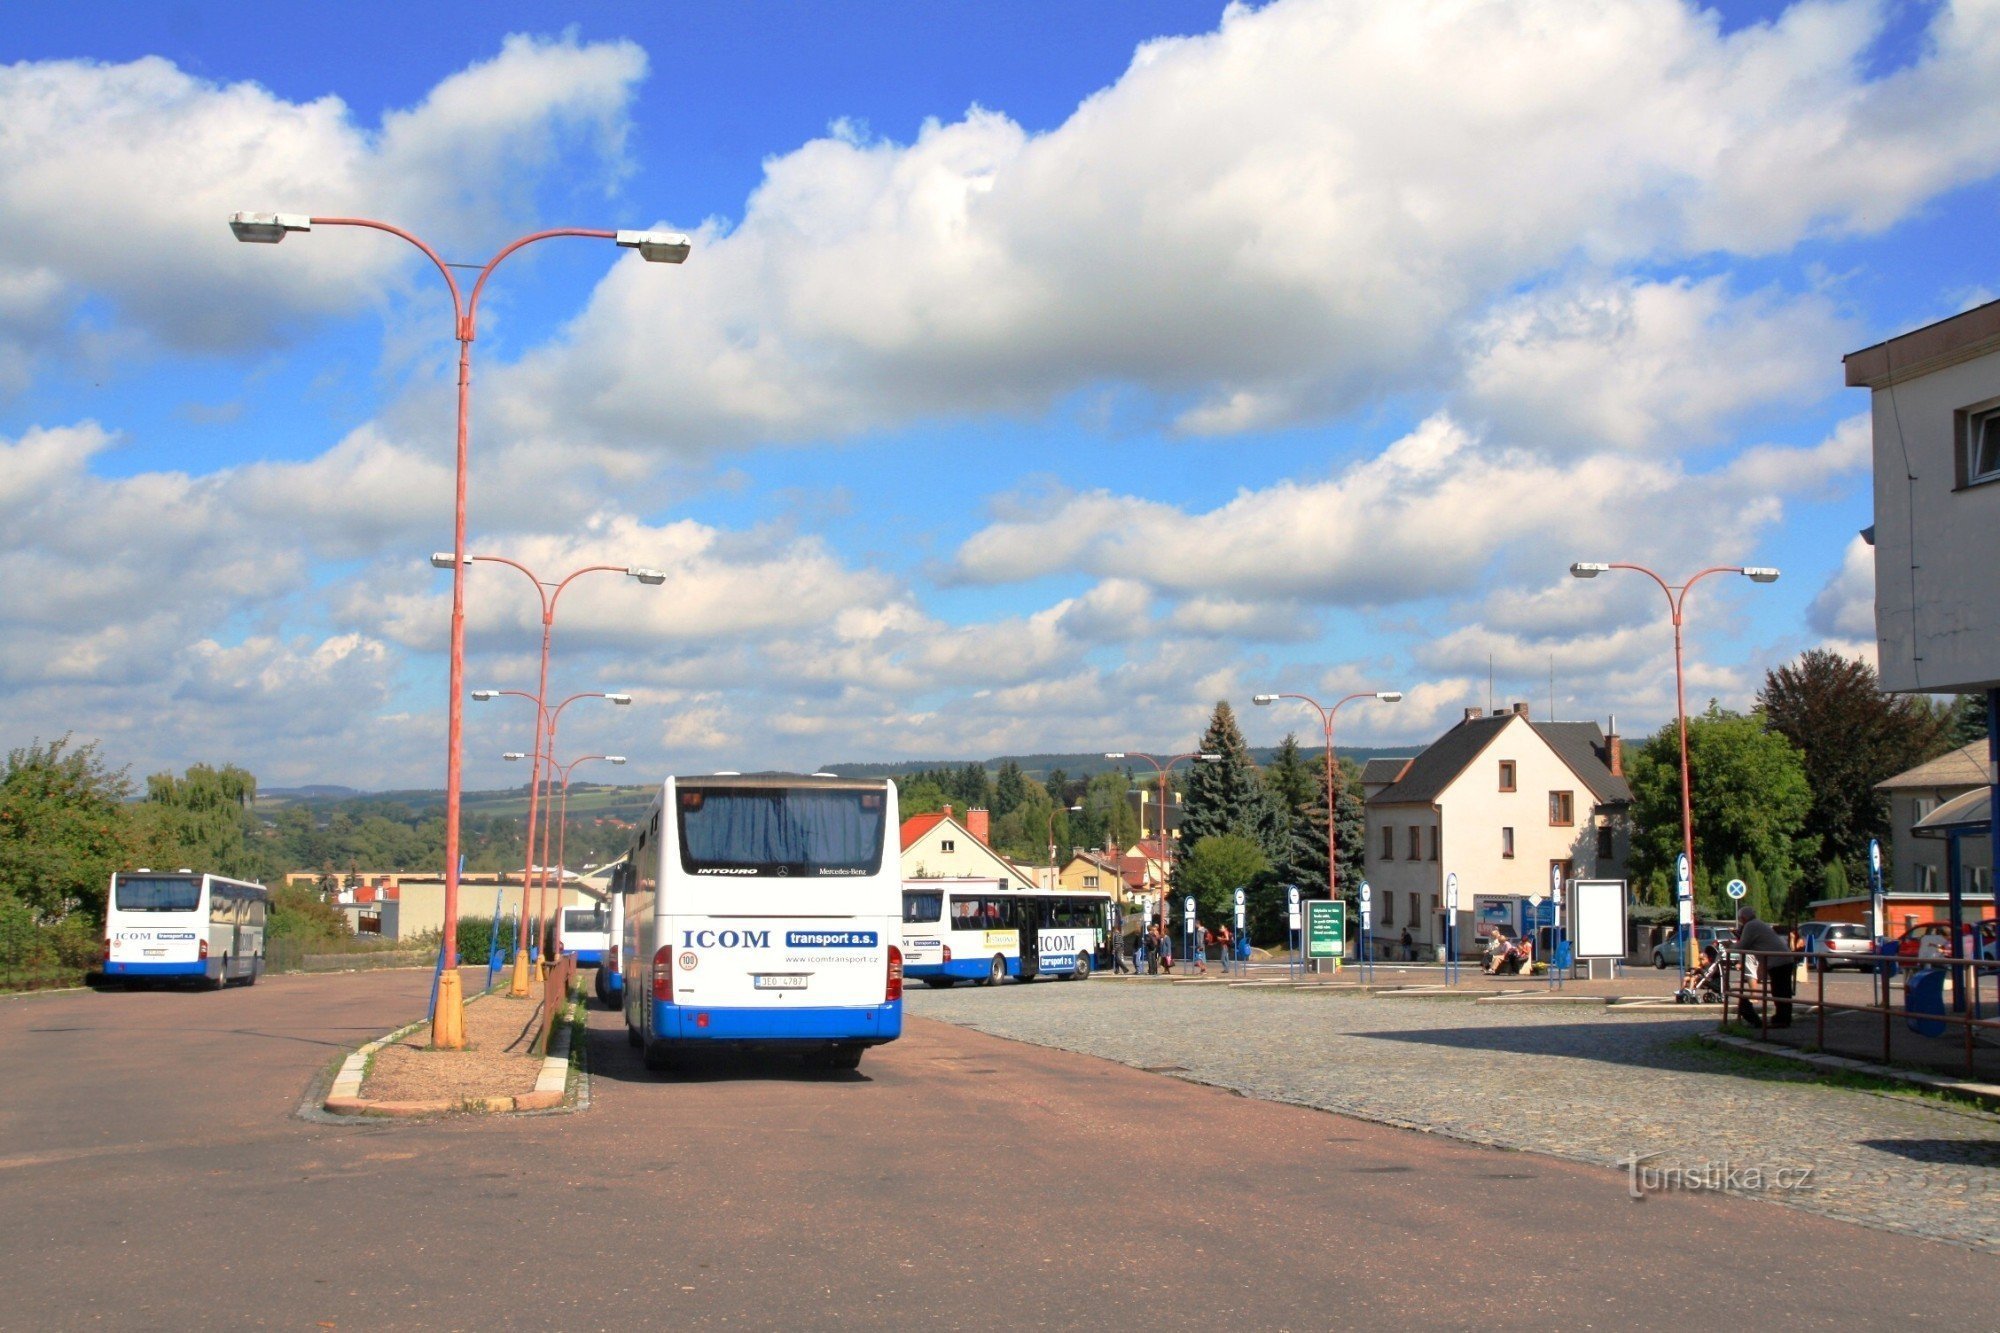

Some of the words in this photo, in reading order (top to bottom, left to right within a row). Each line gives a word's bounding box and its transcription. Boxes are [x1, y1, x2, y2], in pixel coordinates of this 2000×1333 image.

[682, 930, 771, 948] ICOM
[791, 933, 849, 946] transport
[851, 934, 874, 944] a.s.
[1039, 936, 1075, 951] ICOM
[785, 956, 879, 965] www.icomtransport.cz
[1041, 957, 1063, 967] transport
[783, 977, 803, 986] 4787
